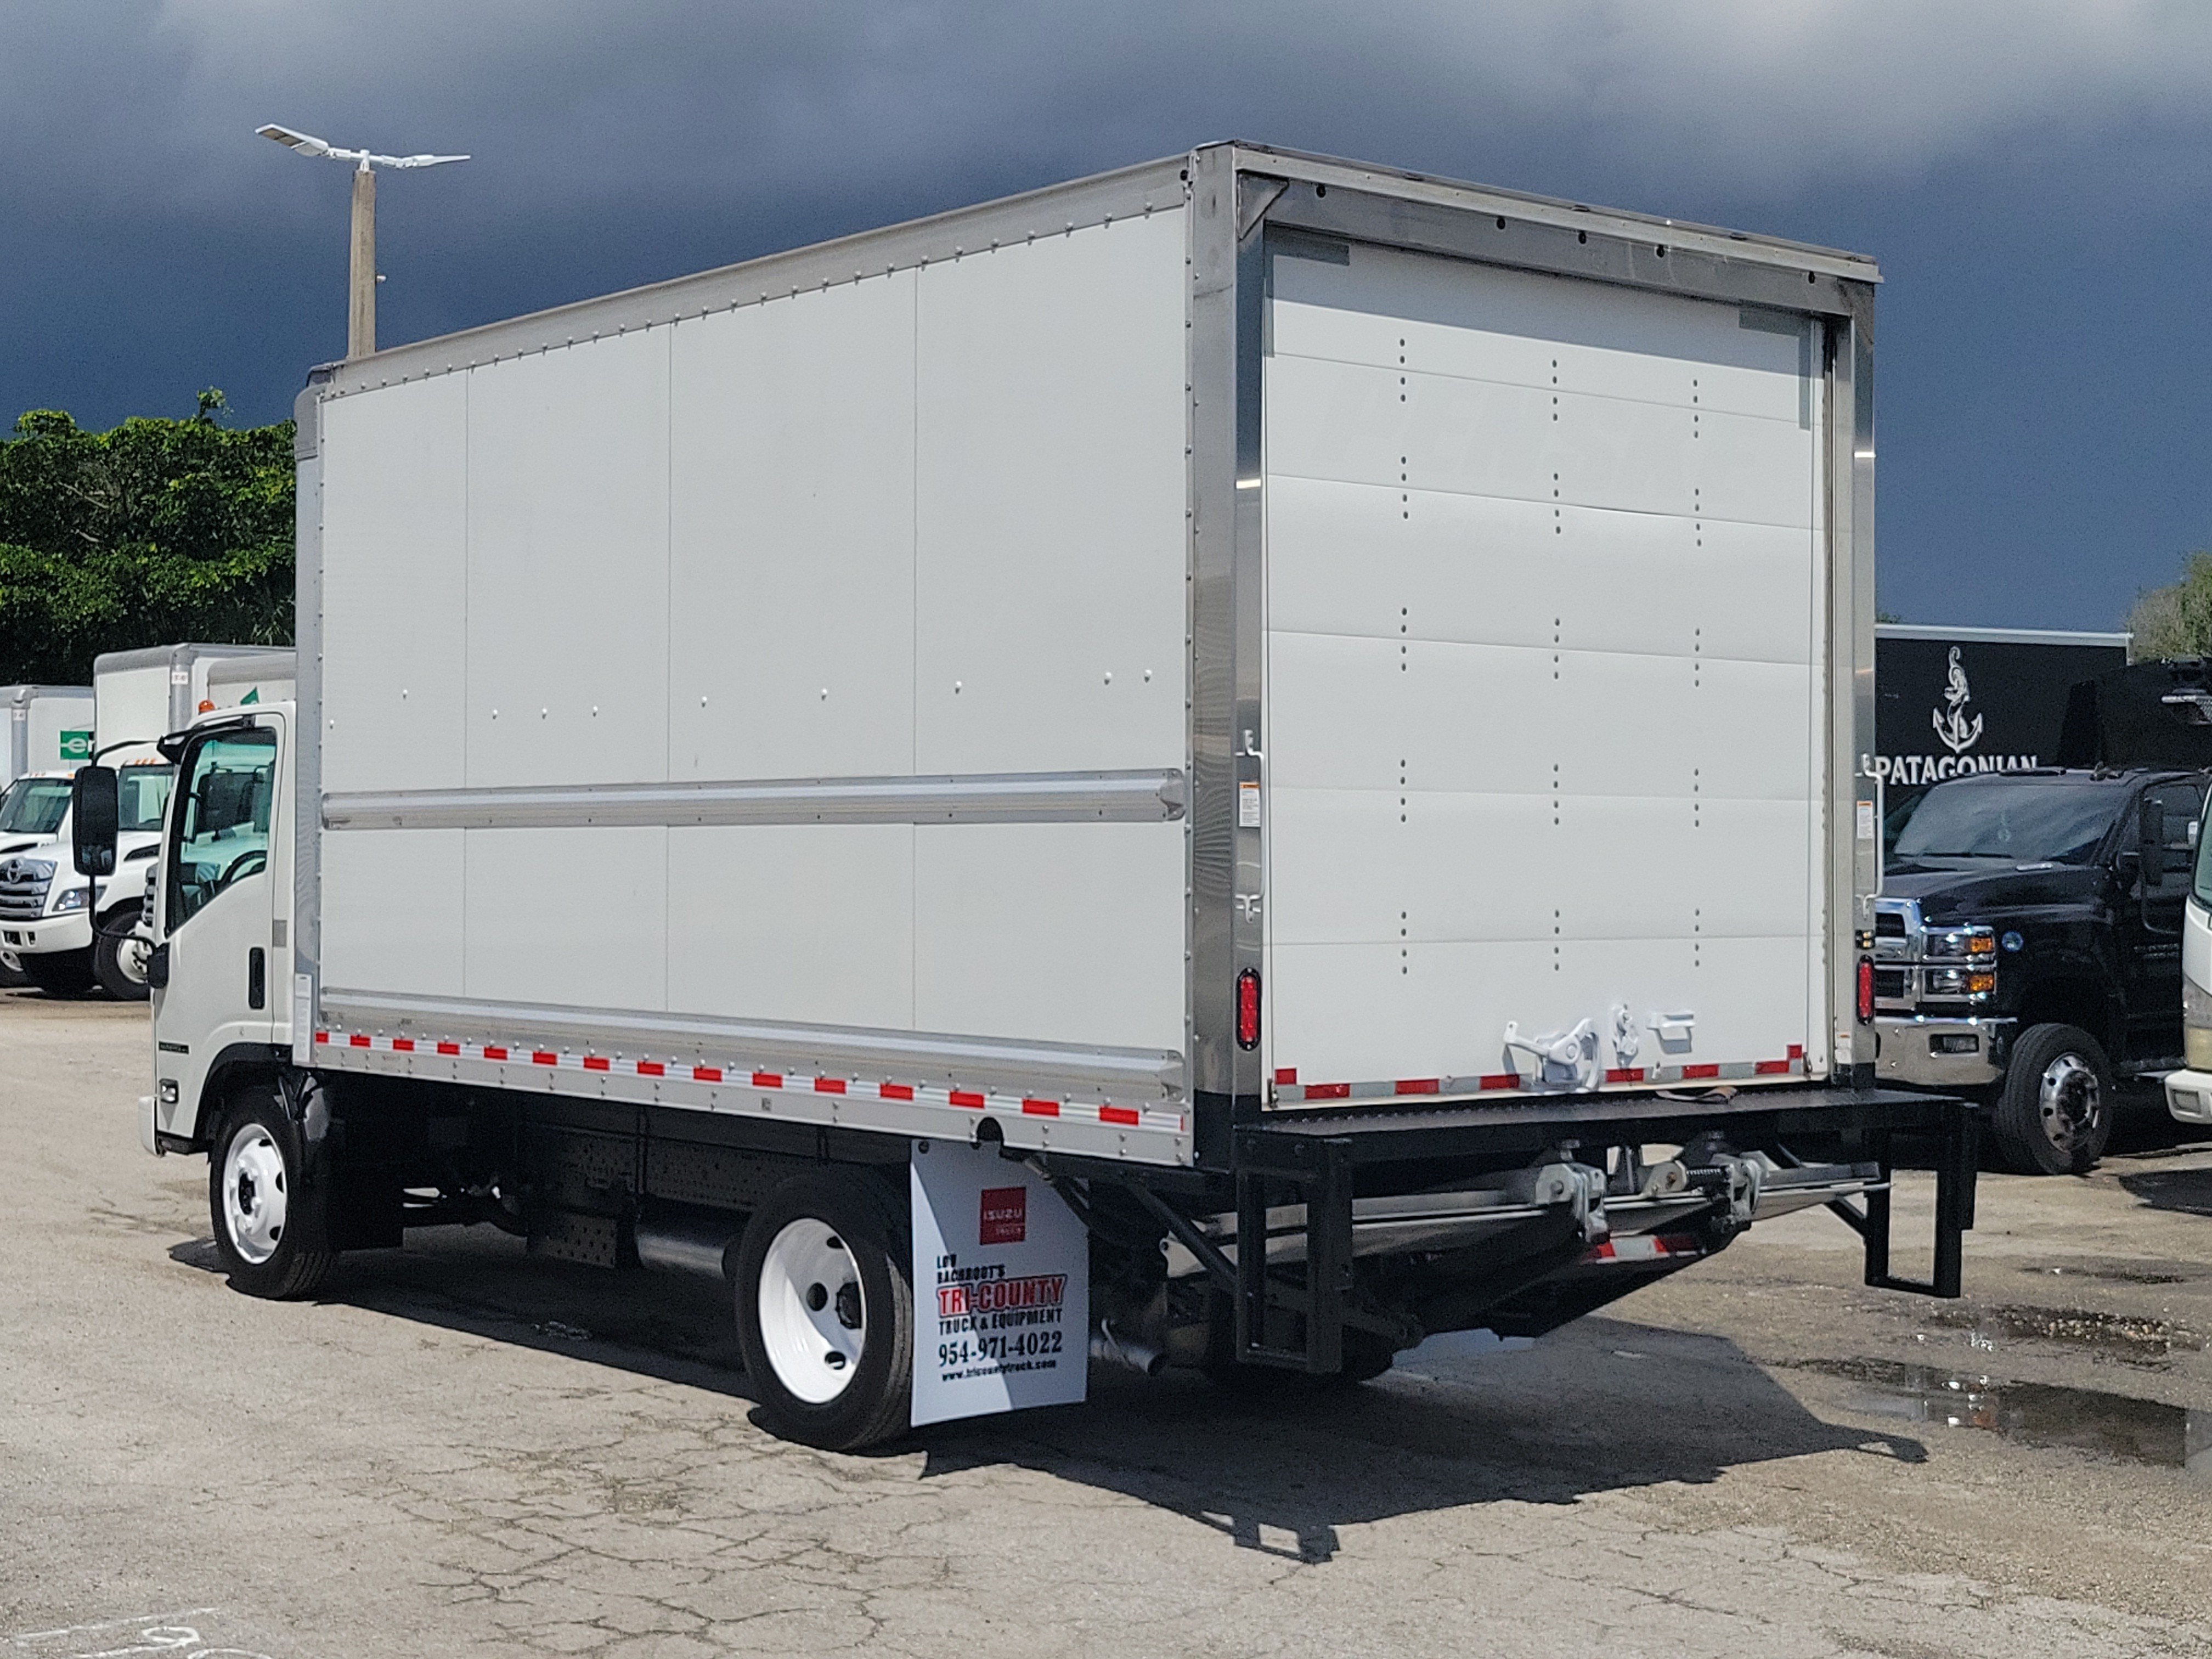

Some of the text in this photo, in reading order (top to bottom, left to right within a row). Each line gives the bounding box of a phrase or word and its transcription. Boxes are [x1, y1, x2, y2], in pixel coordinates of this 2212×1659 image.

[983, 1209, 1023, 1221] ISUZU
[939, 1276, 1065, 1316] TRI-COUNTY
[939, 1308, 1062, 1335] TRUCK & EQUIPMENT
[939, 1330, 1063, 1368] 954-971-4022
